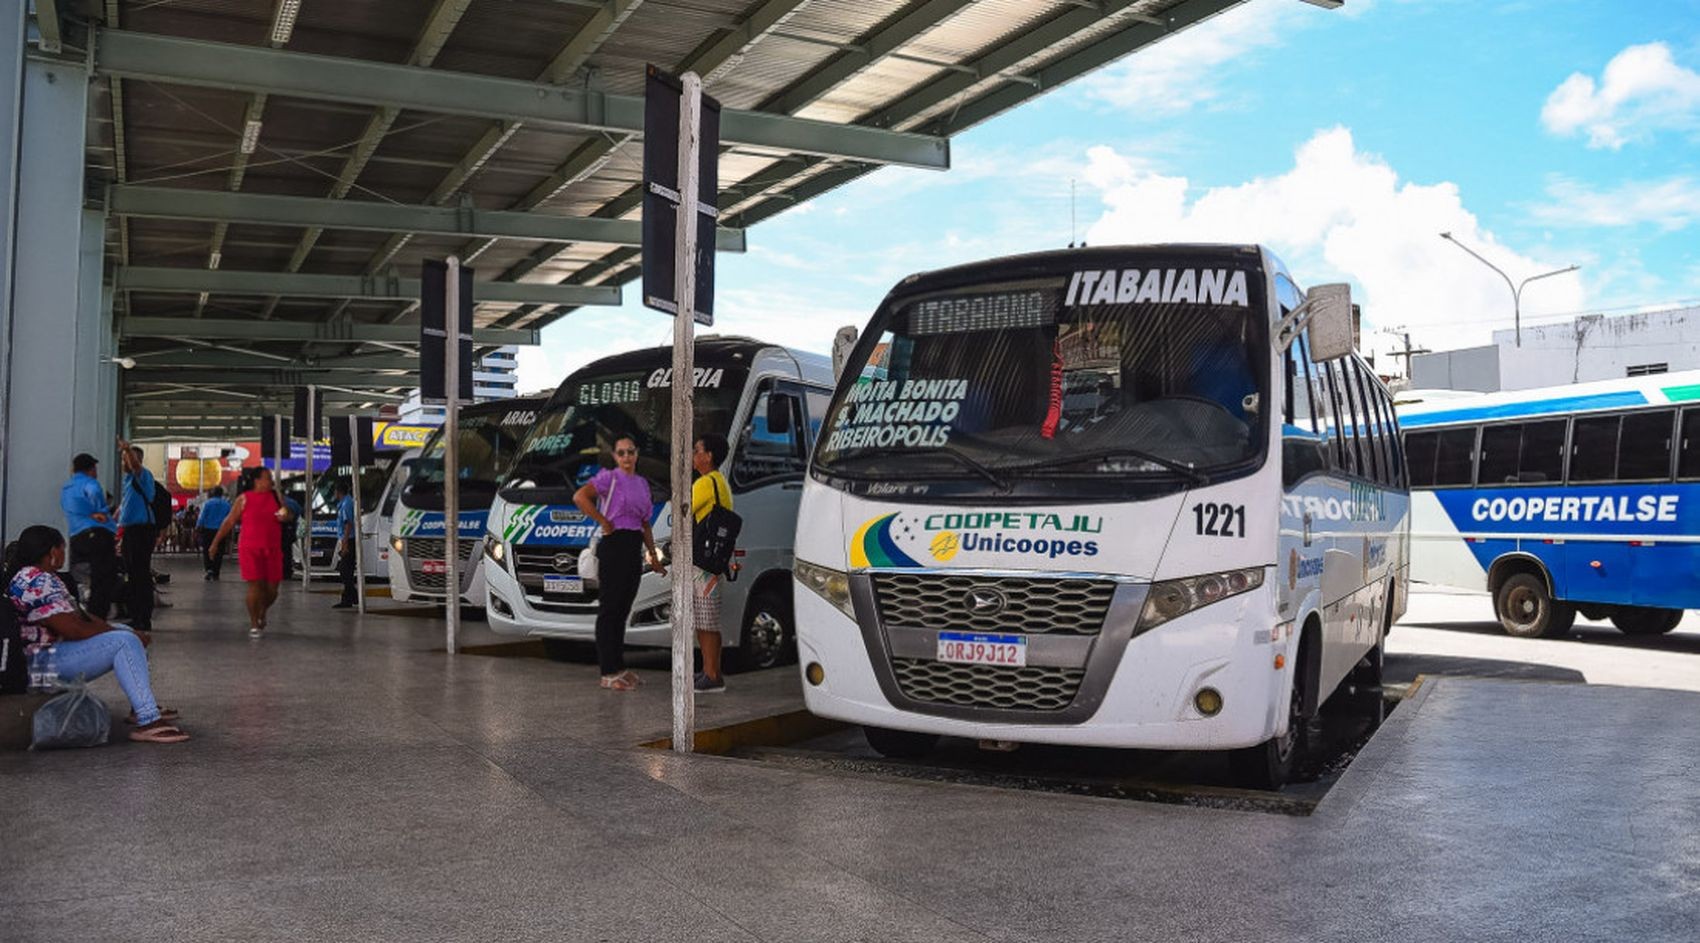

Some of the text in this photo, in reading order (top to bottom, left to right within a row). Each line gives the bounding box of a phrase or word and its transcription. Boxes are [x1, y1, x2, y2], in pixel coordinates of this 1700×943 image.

[1065, 268, 1249, 307] ITABAIANA
[917, 292, 1042, 334] ITABAIANA
[647, 367, 724, 389] GLRIA
[579, 381, 641, 405] GLORIA
[845, 379, 968, 403] MOITA BONITA
[500, 410, 538, 426] ARAC
[854, 401, 960, 425] MACHADO
[867, 483, 908, 495] Volare
[1193, 502, 1245, 538] 1221
[1471, 495, 1680, 522] COOPERTALSE
[923, 512, 1103, 534] COOPETAJU
[962, 533, 1099, 558] Unicoopes
